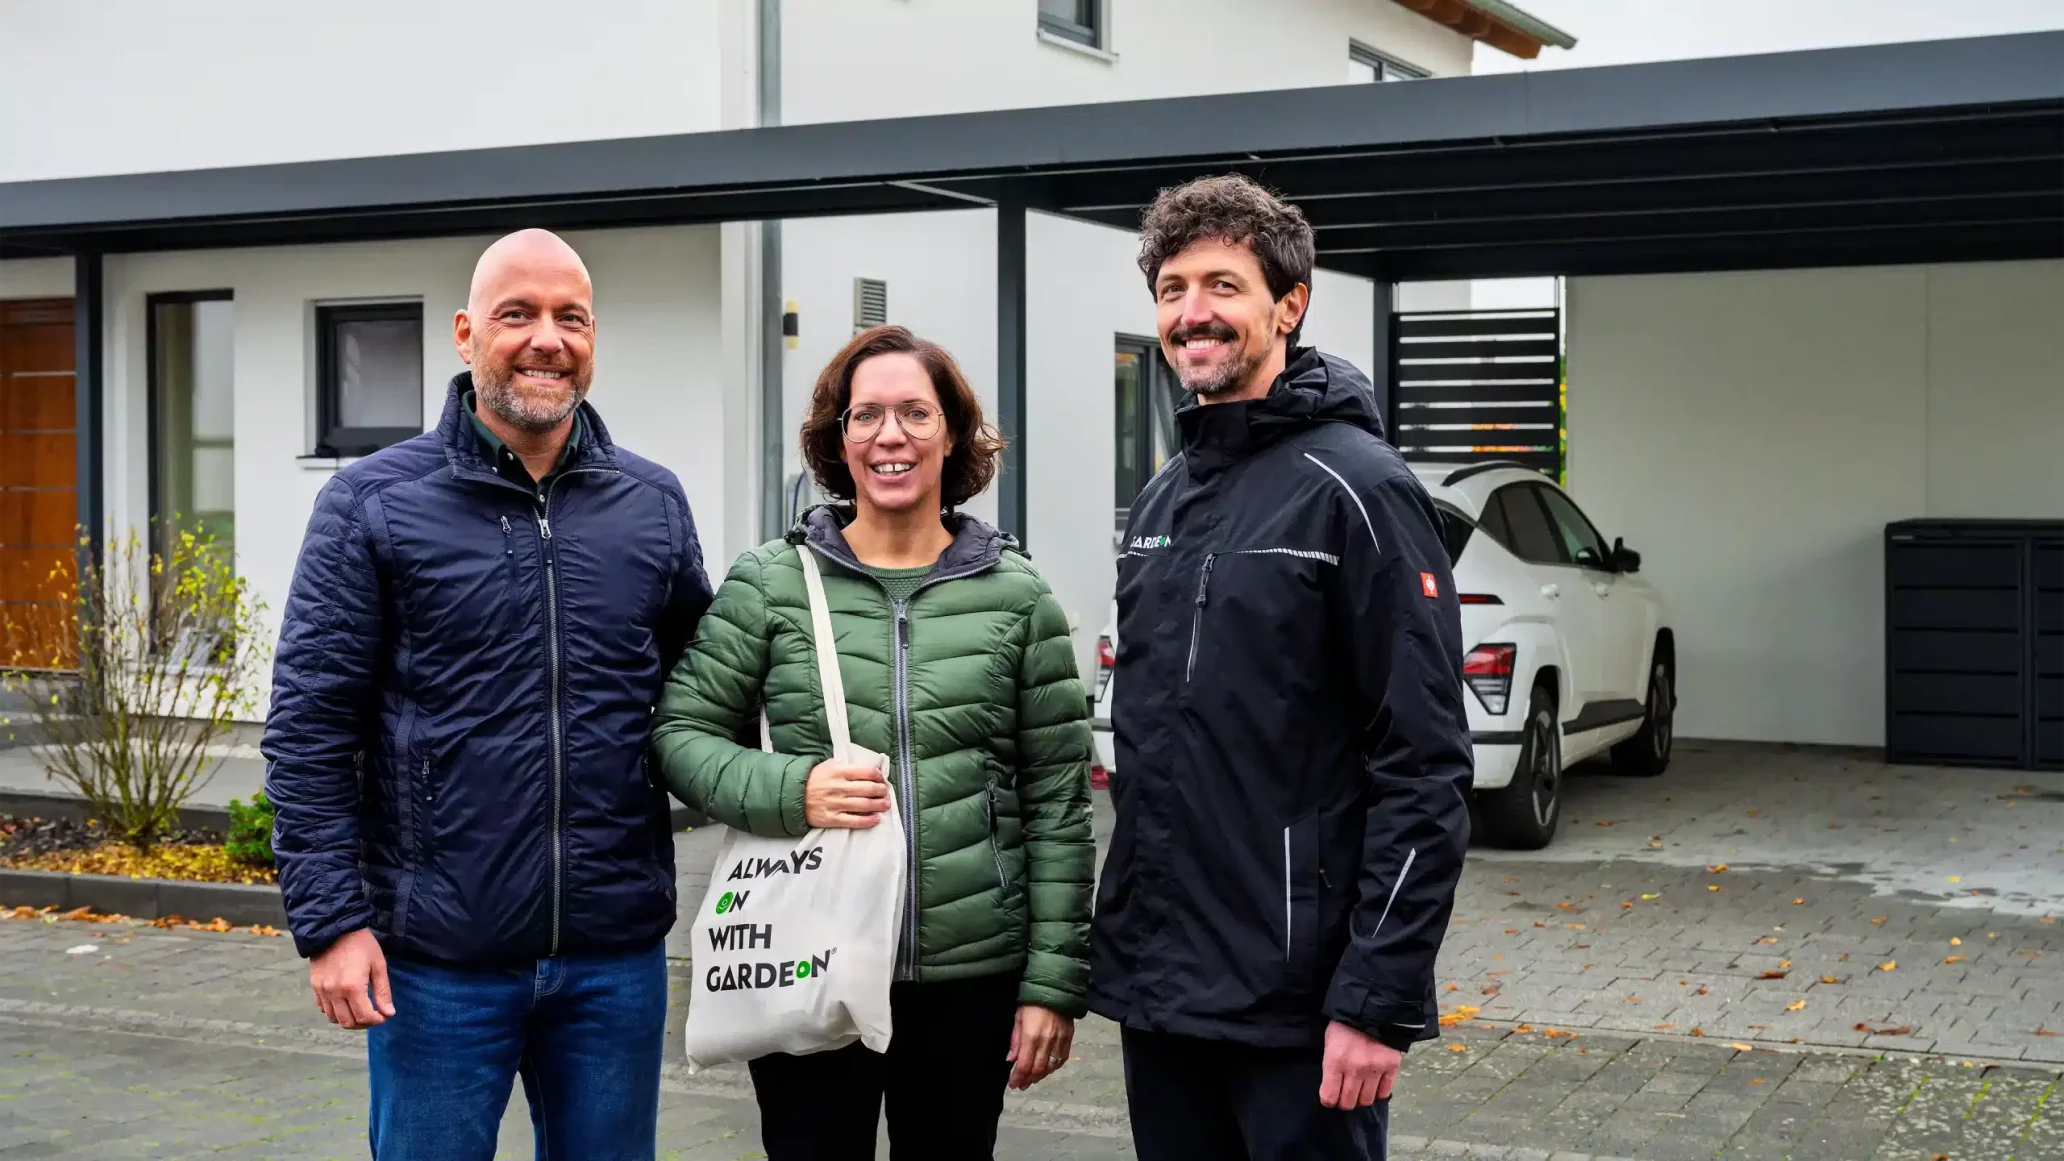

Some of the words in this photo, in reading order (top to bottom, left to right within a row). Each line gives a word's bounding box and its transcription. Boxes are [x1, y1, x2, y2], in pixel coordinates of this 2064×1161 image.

[727, 846, 823, 882] ALWAYS
[715, 890, 751, 915] ON
[708, 923, 772, 953] WITH
